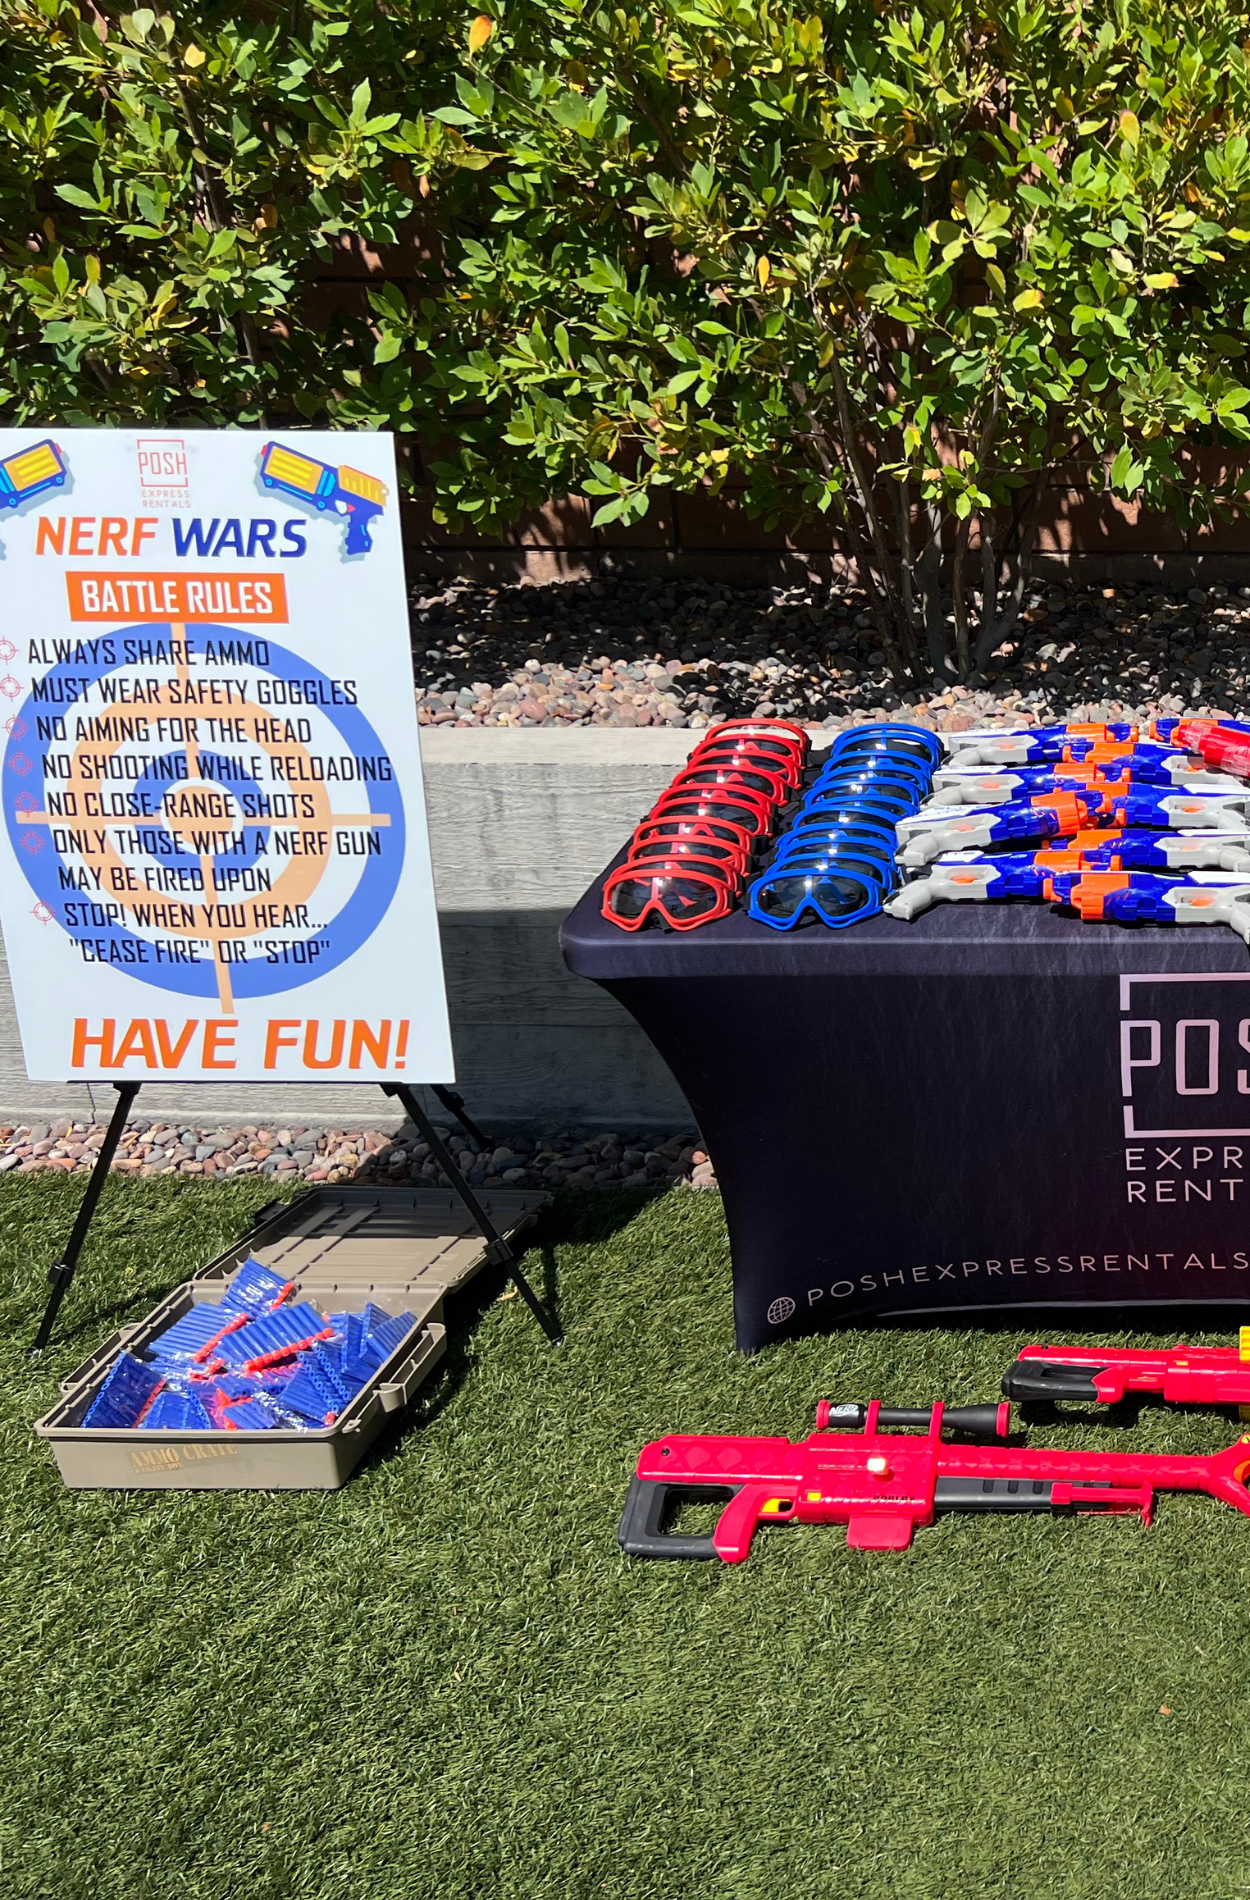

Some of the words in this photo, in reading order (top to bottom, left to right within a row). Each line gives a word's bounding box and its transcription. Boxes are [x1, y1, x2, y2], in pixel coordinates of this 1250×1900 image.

[139, 452, 187, 475] POSH
[141, 490, 189, 498] EXPRESS
[143, 500, 191, 508] RENTALS
[36, 516, 158, 555] NERF
[172, 518, 307, 557] WARS
[82, 581, 179, 613] BATTLE
[189, 582, 272, 614] RULES
[29, 638, 115, 665] ALWAYS
[125, 640, 195, 666] SHARE
[205, 641, 269, 666] AMMO
[32, 677, 91, 703] MUST
[98, 678, 160, 704] WEAR
[170, 679, 249, 704] SAFETY
[258, 680, 357, 705] GOGGLES
[37, 716, 67, 741] NO
[75, 717, 148, 742] AIMING
[158, 717, 198, 742] FOR
[205, 718, 246, 742] THE
[254, 718, 311, 743] HEAD
[42, 754, 72, 779] NO
[81, 755, 189, 780] SHOOTING
[199, 756, 262, 781] WHILE
[271, 757, 391, 781] RELOADING
[47, 792, 77, 816] NO
[86, 793, 236, 817] CLOSE-RANGE
[244, 794, 315, 818] SHOTS
[54, 830, 108, 854] ONLY
[116, 831, 184, 854] THOSE
[192, 831, 246, 855] WITH
[254, 832, 268, 855] A
[275, 832, 328, 855] NERF
[337, 832, 381, 855] GUN
[59, 866, 105, 890] MAY
[112, 867, 138, 891] BE
[145, 868, 205, 891] FIRED
[213, 868, 272, 892] UPON
[65, 904, 127, 927] STOP!
[133, 904, 196, 927] WHEN
[204, 905, 245, 928] YOU
[254, 905, 328, 928] HEAR...
[69, 939, 148, 963] "CEASE
[156, 940, 209, 963] FIRE"
[219, 940, 247, 963] OR
[254, 941, 330, 963] "STOP"
[71, 1017, 239, 1069] HAVE
[264, 1019, 410, 1070] FUN!
[131, 1448, 180, 1467] AMMO
[182, 1443, 238, 1460] CRATE
